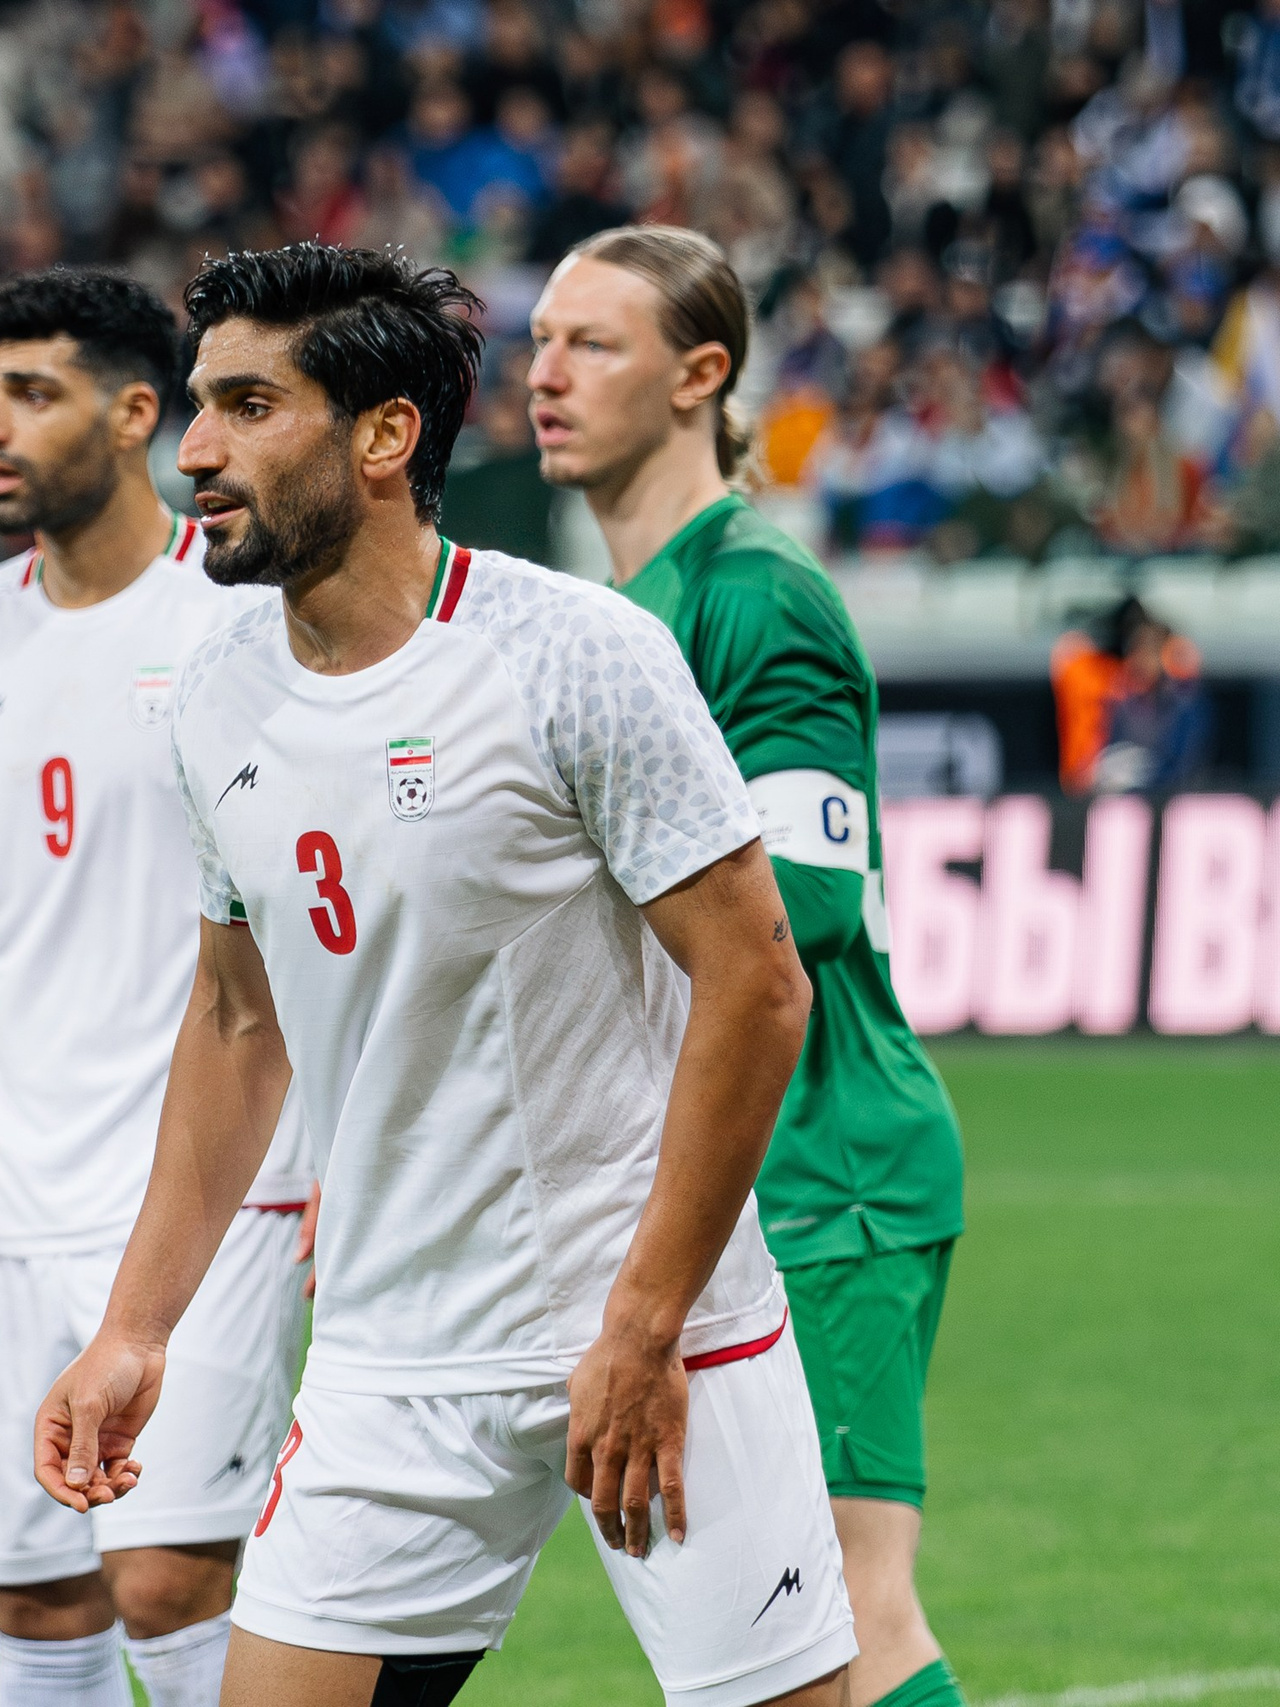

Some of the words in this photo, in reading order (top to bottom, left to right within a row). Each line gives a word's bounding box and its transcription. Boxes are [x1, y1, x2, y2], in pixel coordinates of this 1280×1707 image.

[40, 755, 75, 859] 9
[822, 796, 849, 843] C
[296, 830, 357, 956] 3
[880, 794, 1280, 1036] БЫВ
